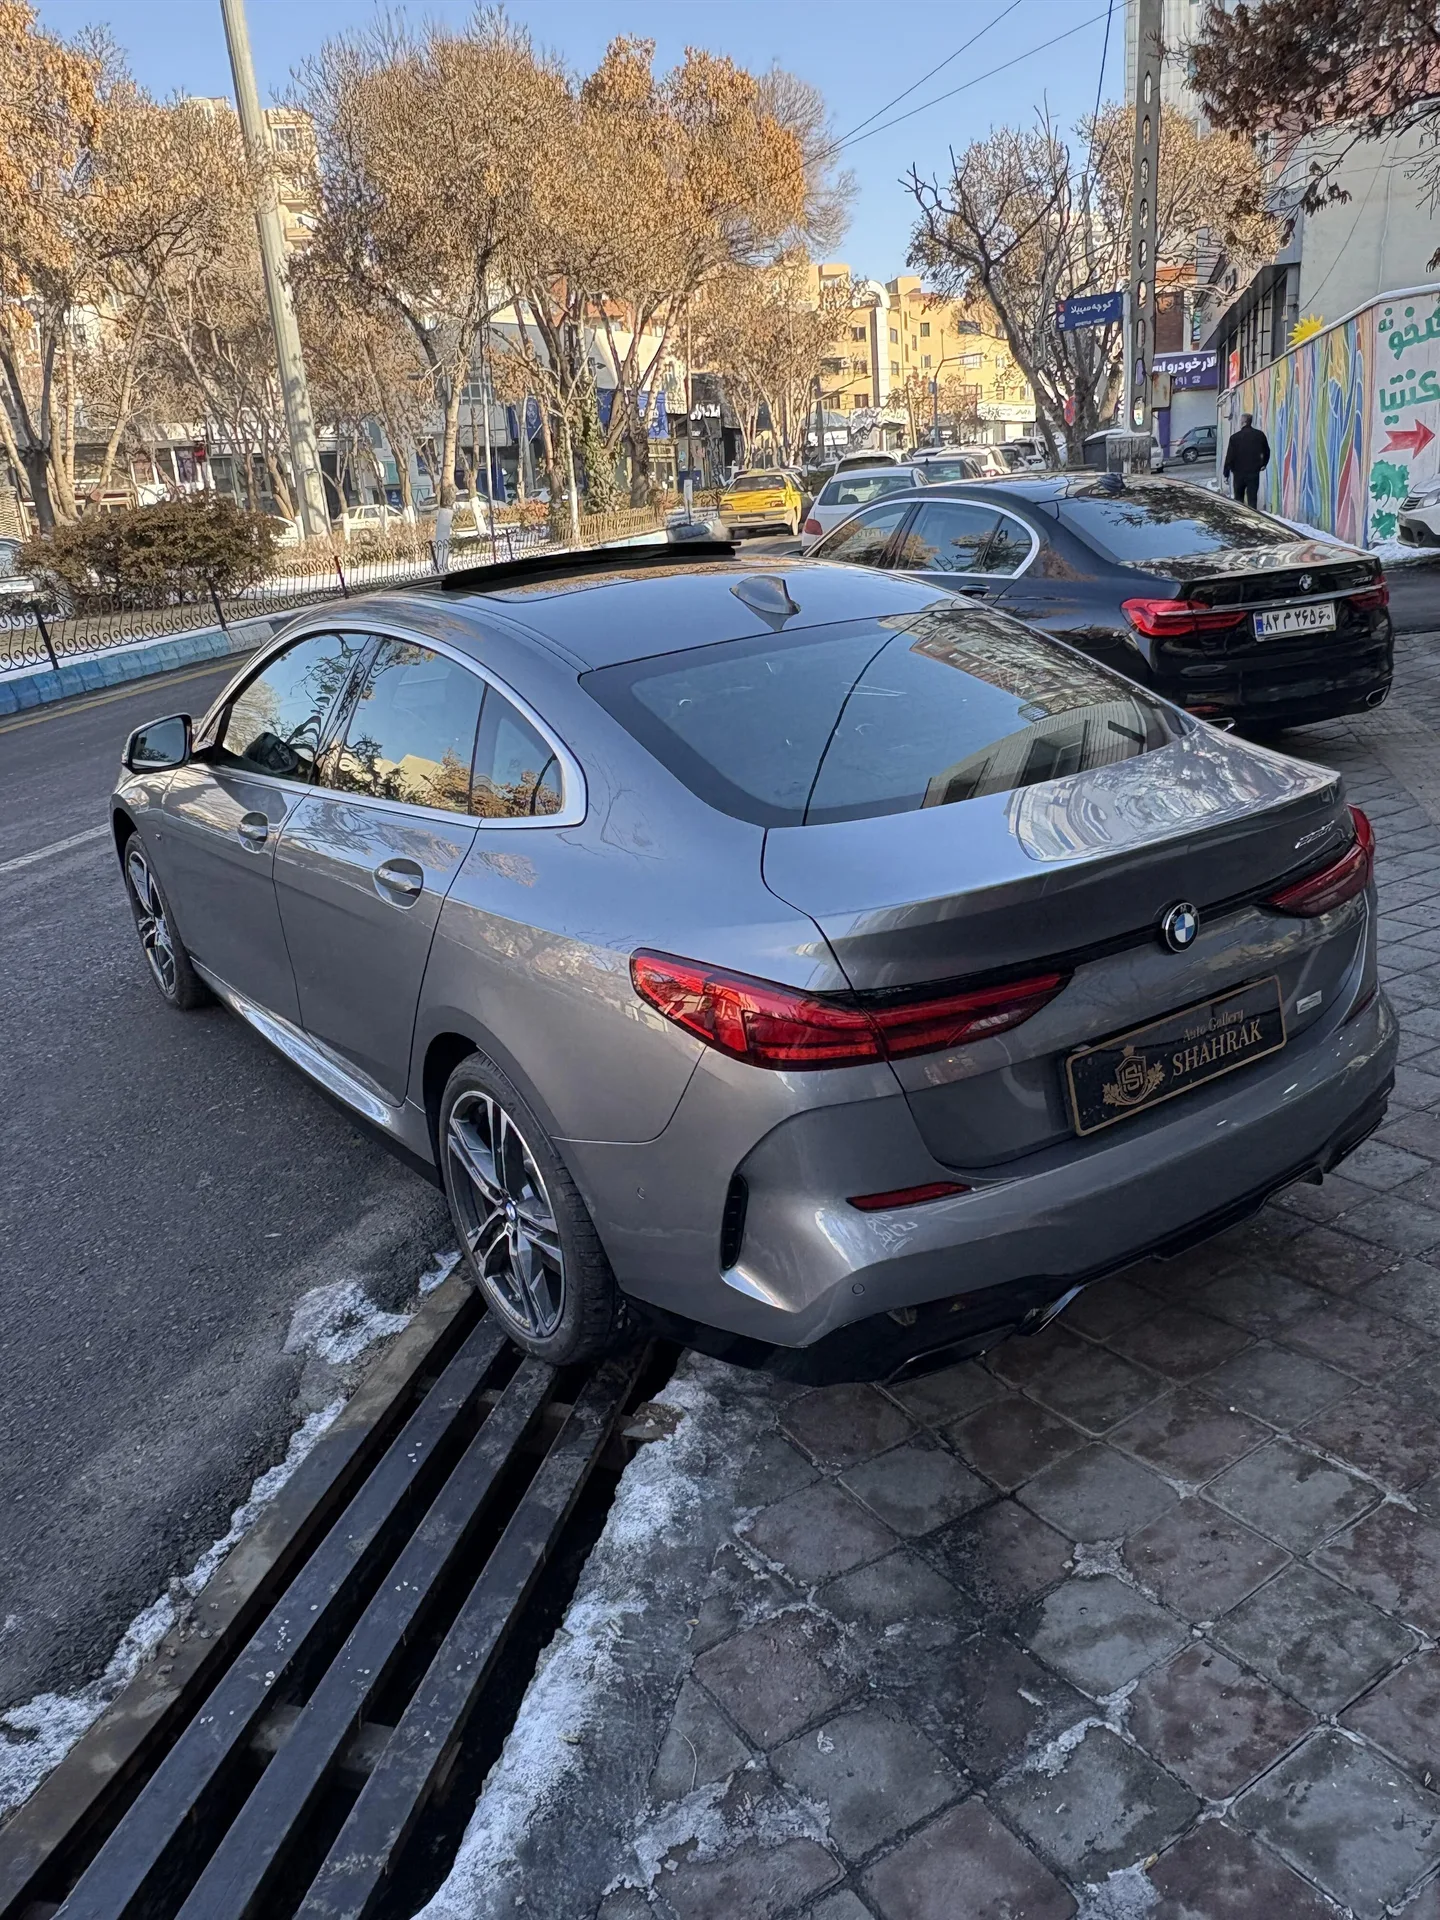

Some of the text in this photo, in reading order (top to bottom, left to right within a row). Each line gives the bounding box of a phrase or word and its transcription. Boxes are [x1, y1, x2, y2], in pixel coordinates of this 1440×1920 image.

[1092, 298, 1115, 312] کوچه
[1167, 357, 1201, 374] خودرو
[1182, 1009, 1244, 1043] Auto Gallery
[1172, 1017, 1263, 1077] SHAHRAK
